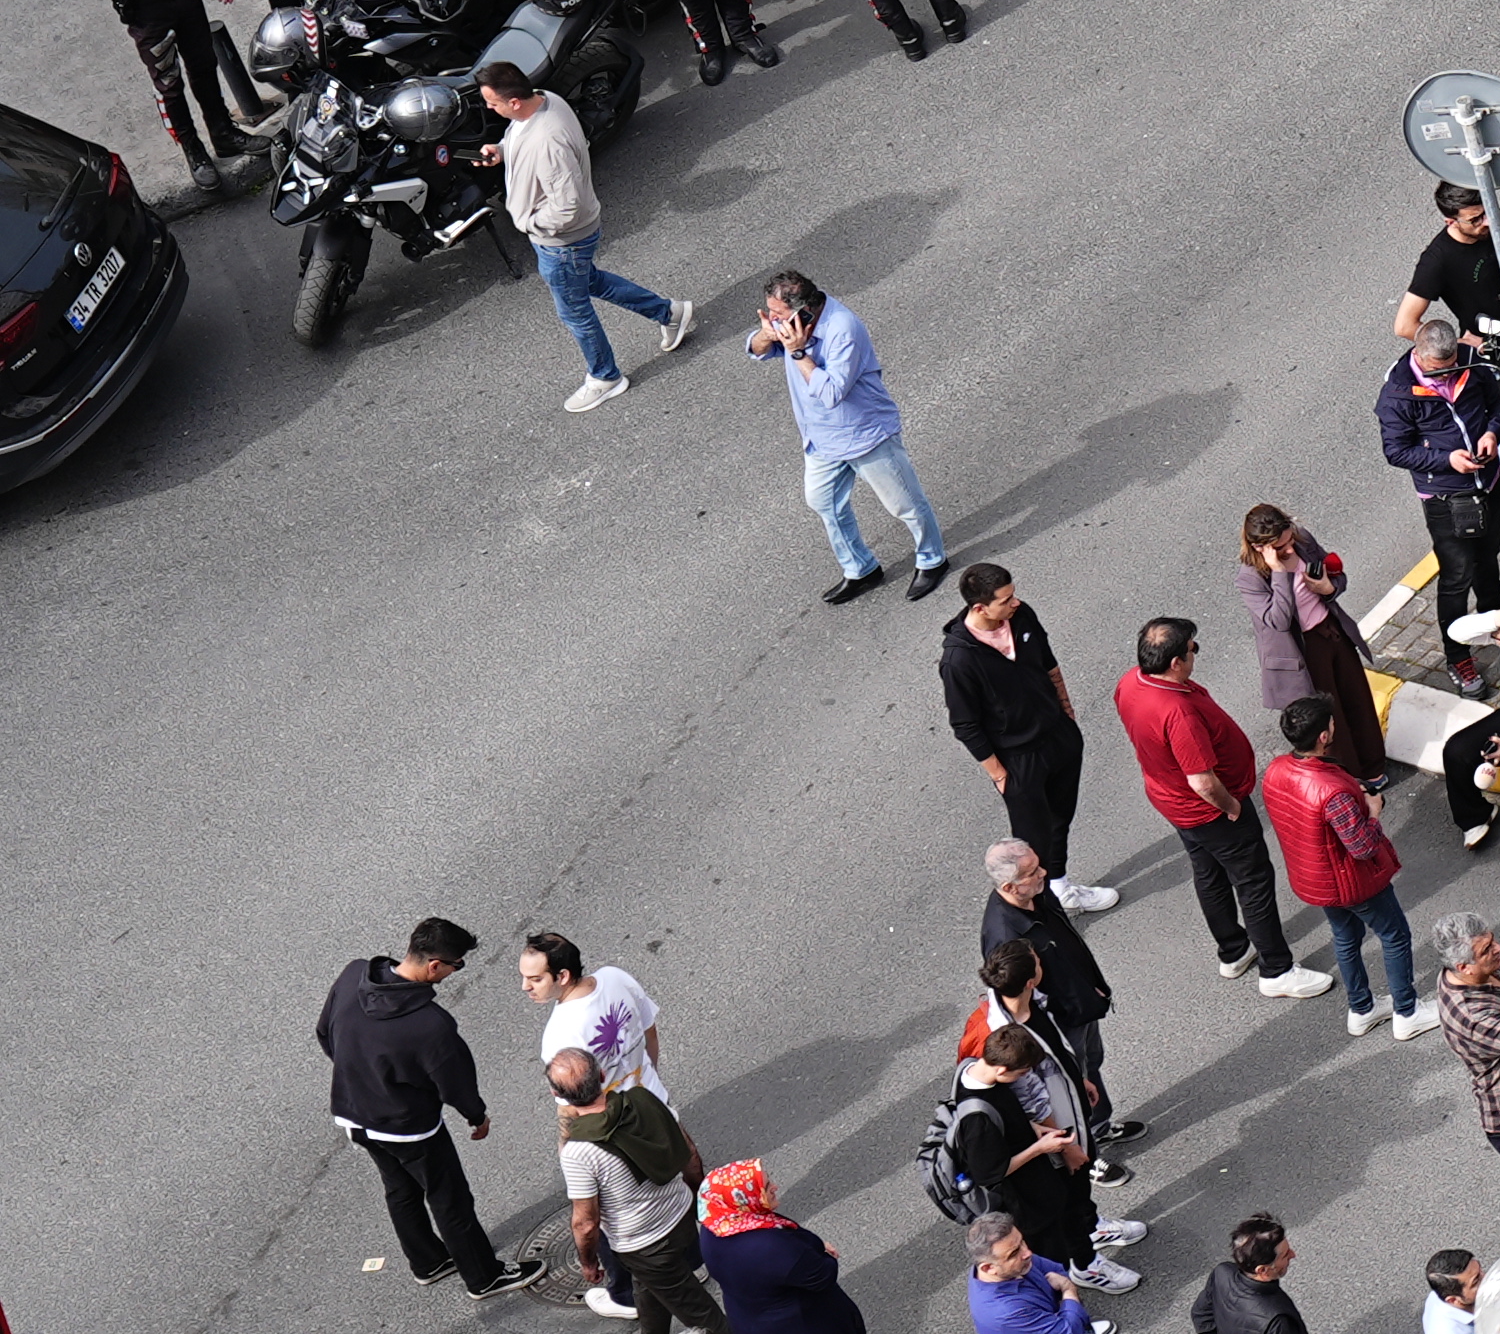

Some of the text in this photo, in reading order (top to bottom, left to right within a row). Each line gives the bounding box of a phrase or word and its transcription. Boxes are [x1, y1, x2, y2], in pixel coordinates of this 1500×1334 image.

[72, 252, 121, 323] 34 TR 3207
